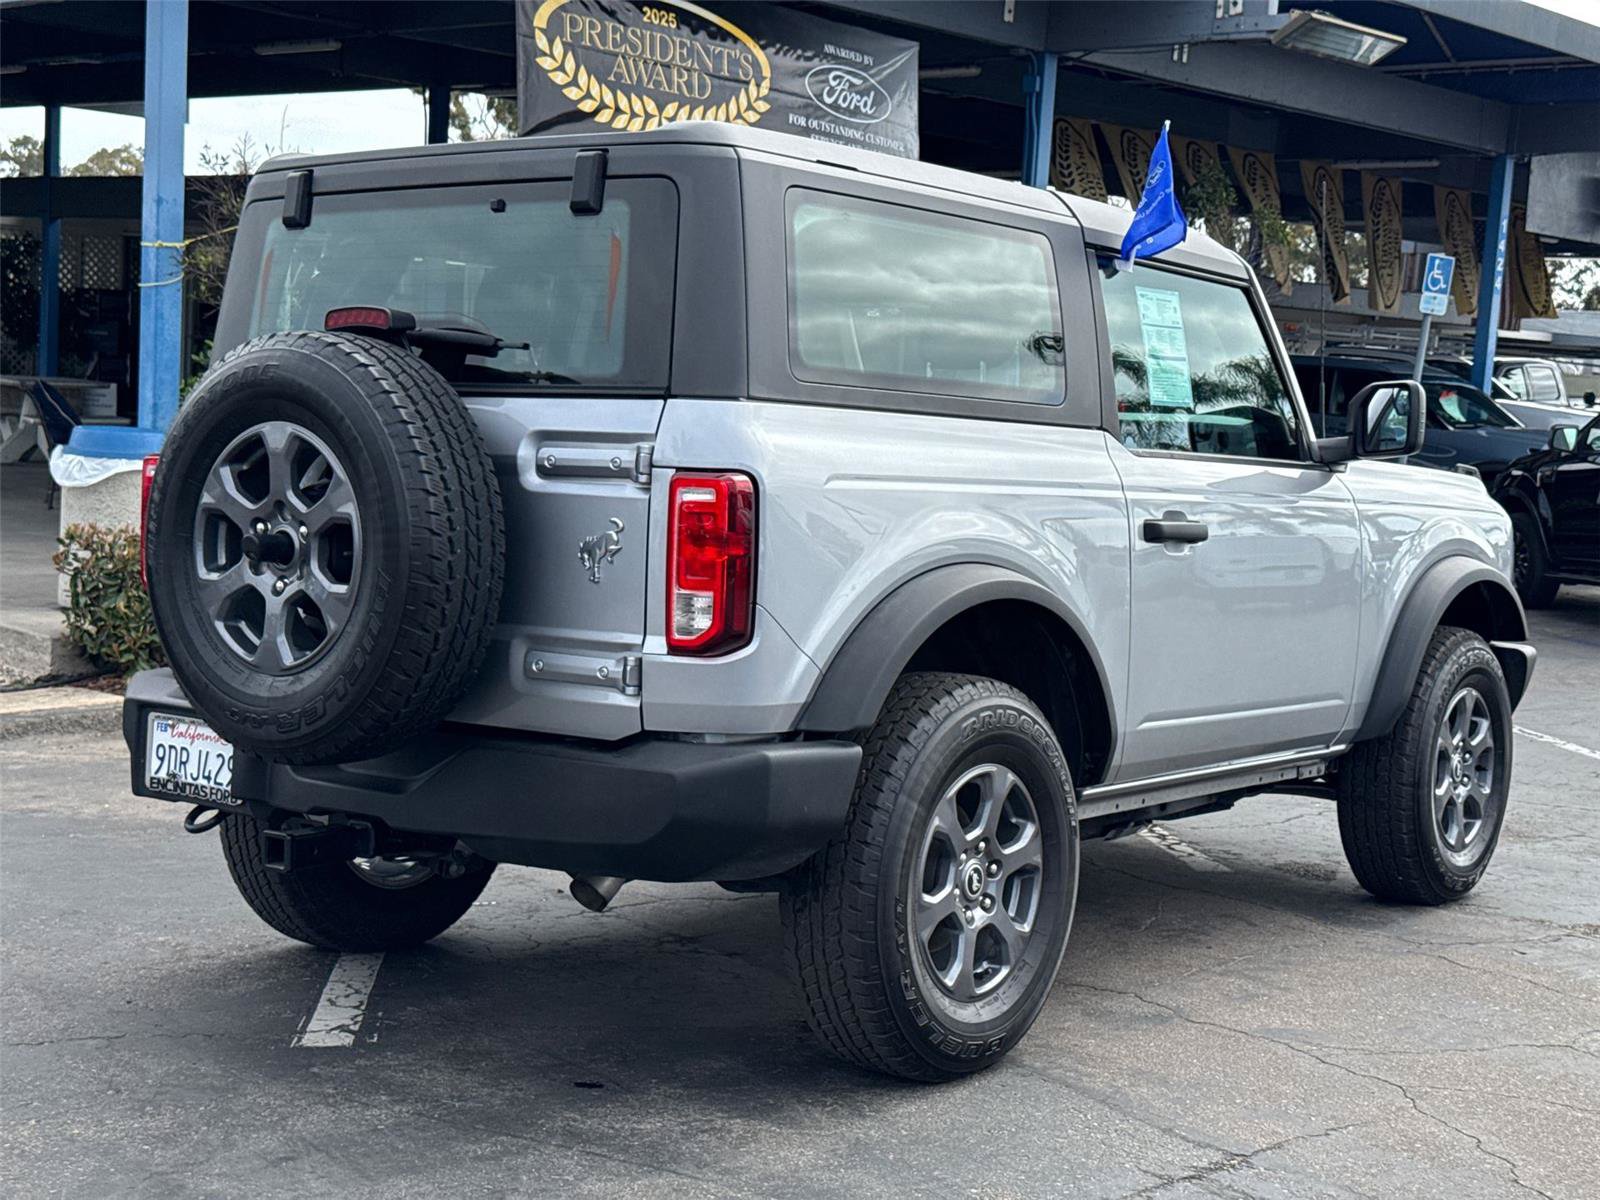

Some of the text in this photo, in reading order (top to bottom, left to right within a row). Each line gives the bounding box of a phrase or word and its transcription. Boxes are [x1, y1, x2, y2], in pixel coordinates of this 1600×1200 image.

[642, 6, 678, 28] 2025
[562, 12, 753, 81] PRESIDENT'S
[824, 44, 874, 66] AWARDED BY
[607, 54, 712, 100] AWARD
[823, 71, 876, 114] Ford
[788, 113, 807, 128] FOR
[808, 119, 865, 141] OUTSTANDING
[865, 132, 905, 152] CUSTOMER
[157, 721, 168, 732] FEB
[171, 720, 229, 747] California
[155, 743, 234, 788] 9DRJ429
[150, 777, 208, 799] ENCINITAS
